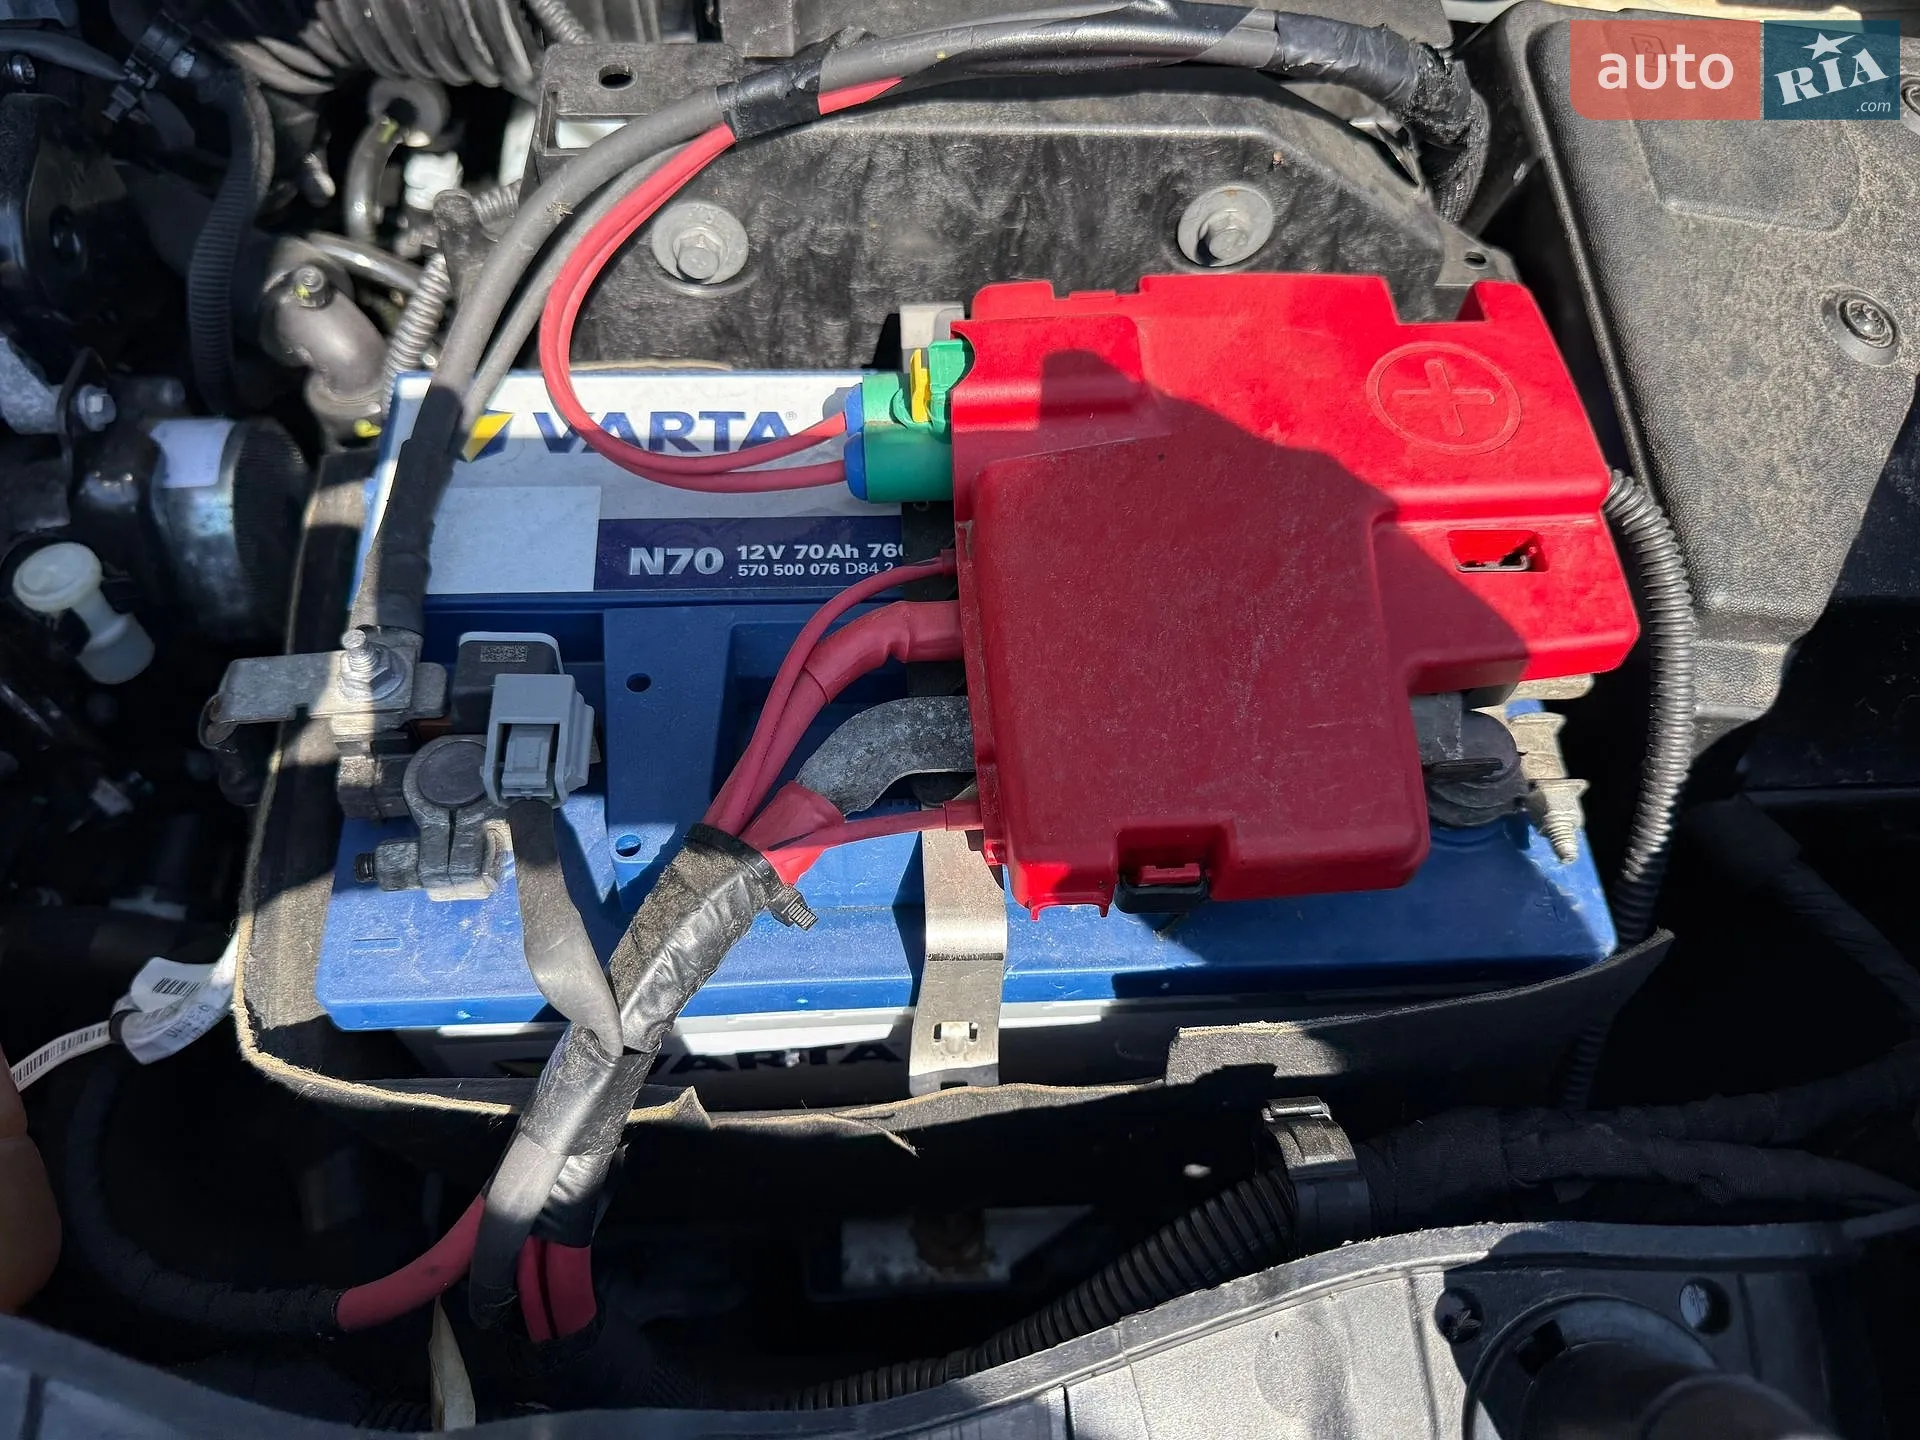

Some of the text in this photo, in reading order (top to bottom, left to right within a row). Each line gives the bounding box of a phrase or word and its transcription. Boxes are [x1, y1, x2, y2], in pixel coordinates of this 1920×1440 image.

[532, 410, 792, 455] VARTA
[628, 546, 725, 577] N70
[737, 544, 786, 561] 12V
[737, 564, 769, 577] 570
[773, 563, 805, 577] 500
[809, 563, 840, 576] 076
[845, 562, 880, 575] D84
